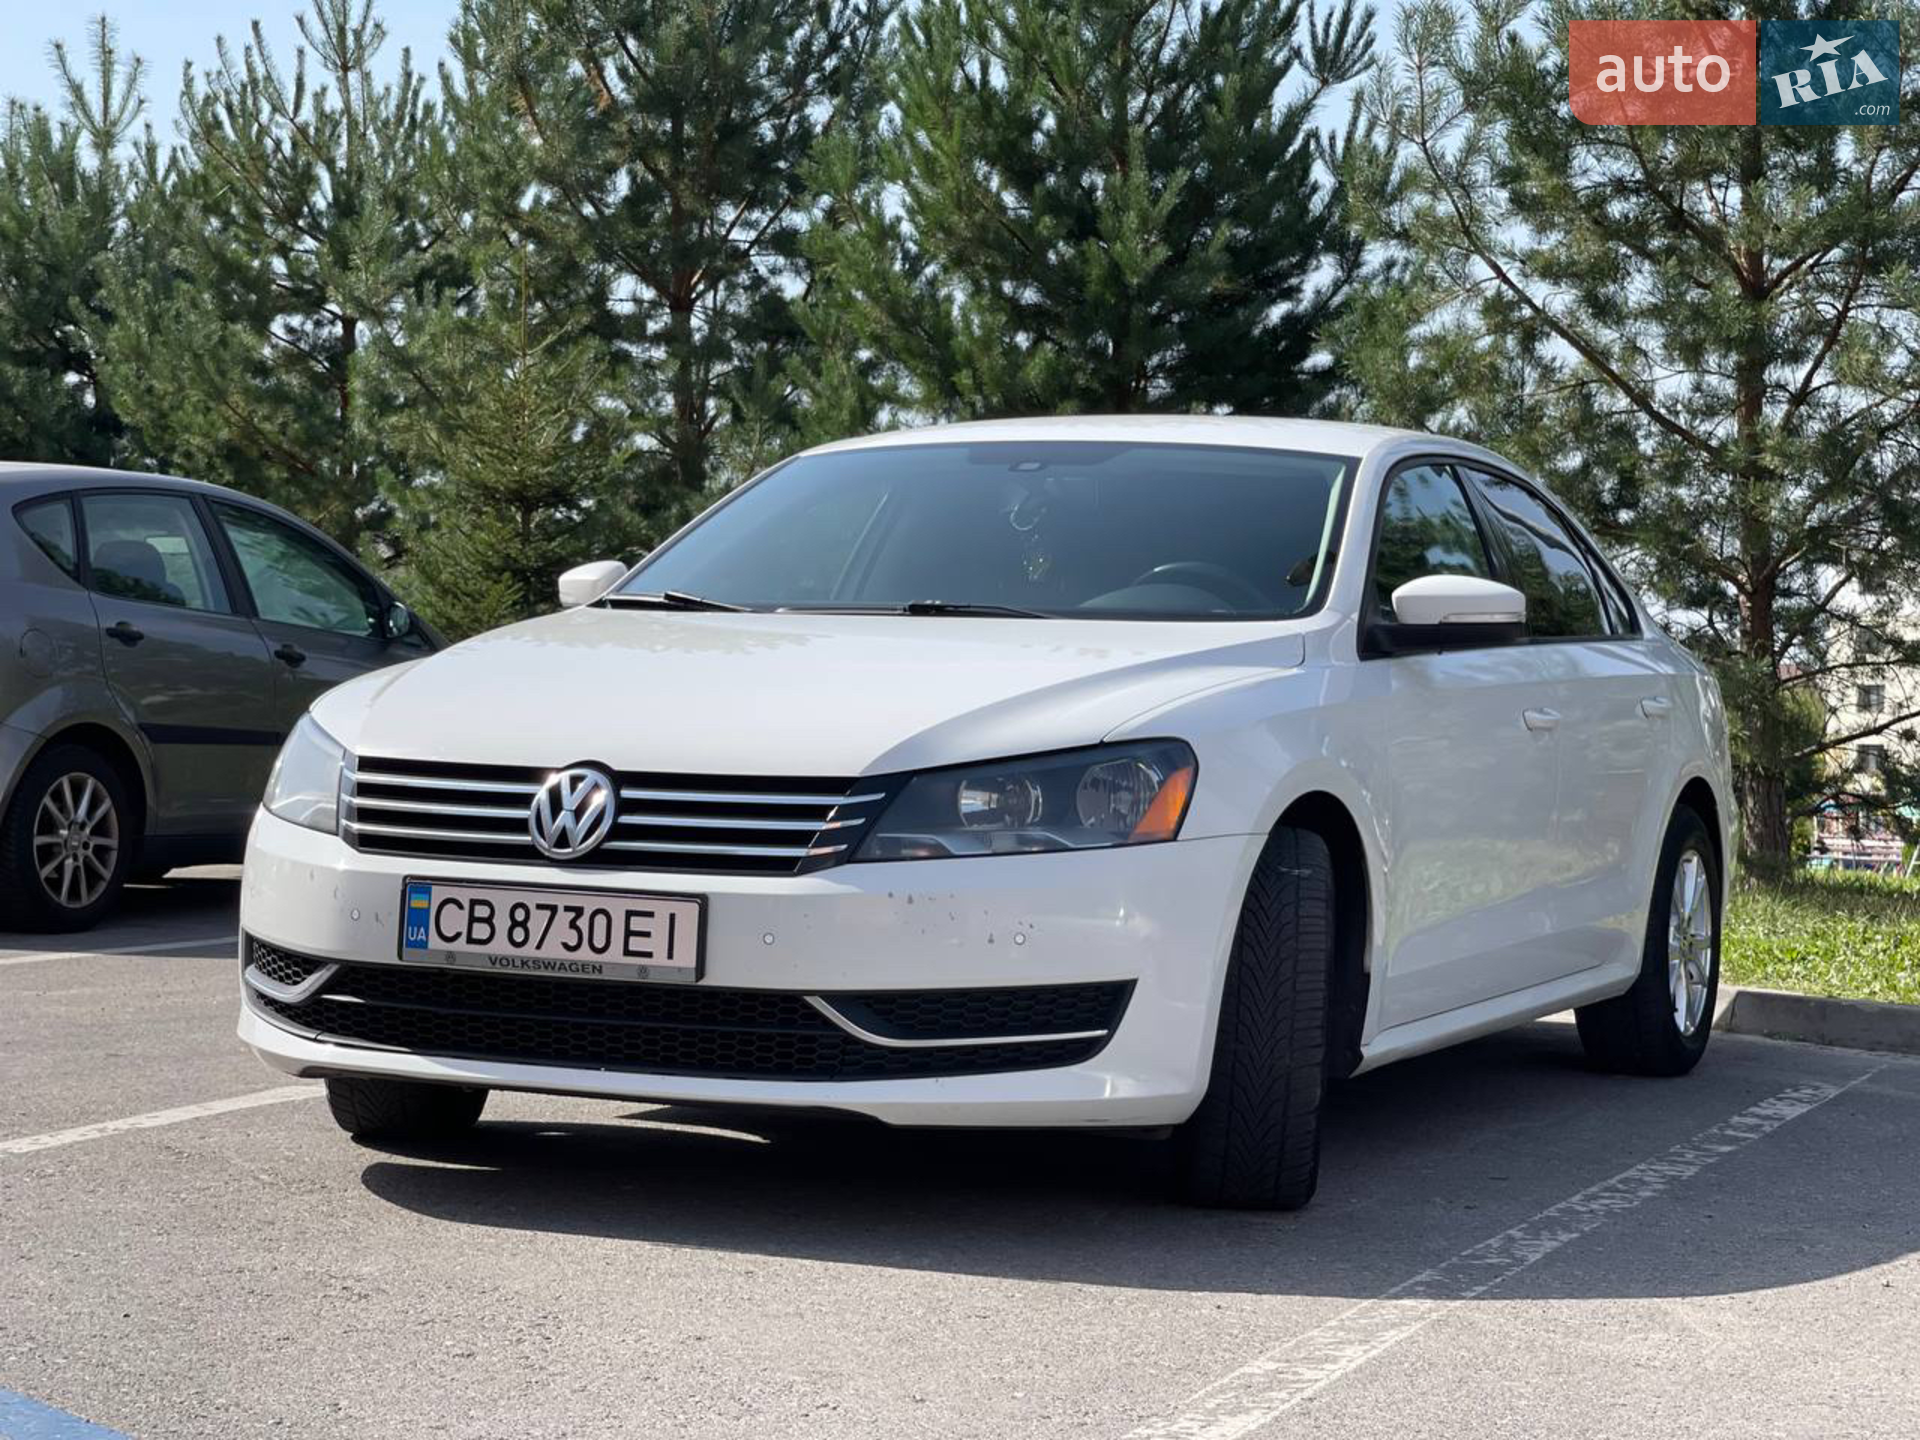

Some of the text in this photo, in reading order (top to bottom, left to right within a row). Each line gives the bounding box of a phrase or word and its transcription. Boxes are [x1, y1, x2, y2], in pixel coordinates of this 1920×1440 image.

[408, 926, 427, 941] UA
[434, 897, 496, 946] CB
[506, 902, 613, 955] 8730
[488, 955, 603, 975] VOLKSWAGEN
